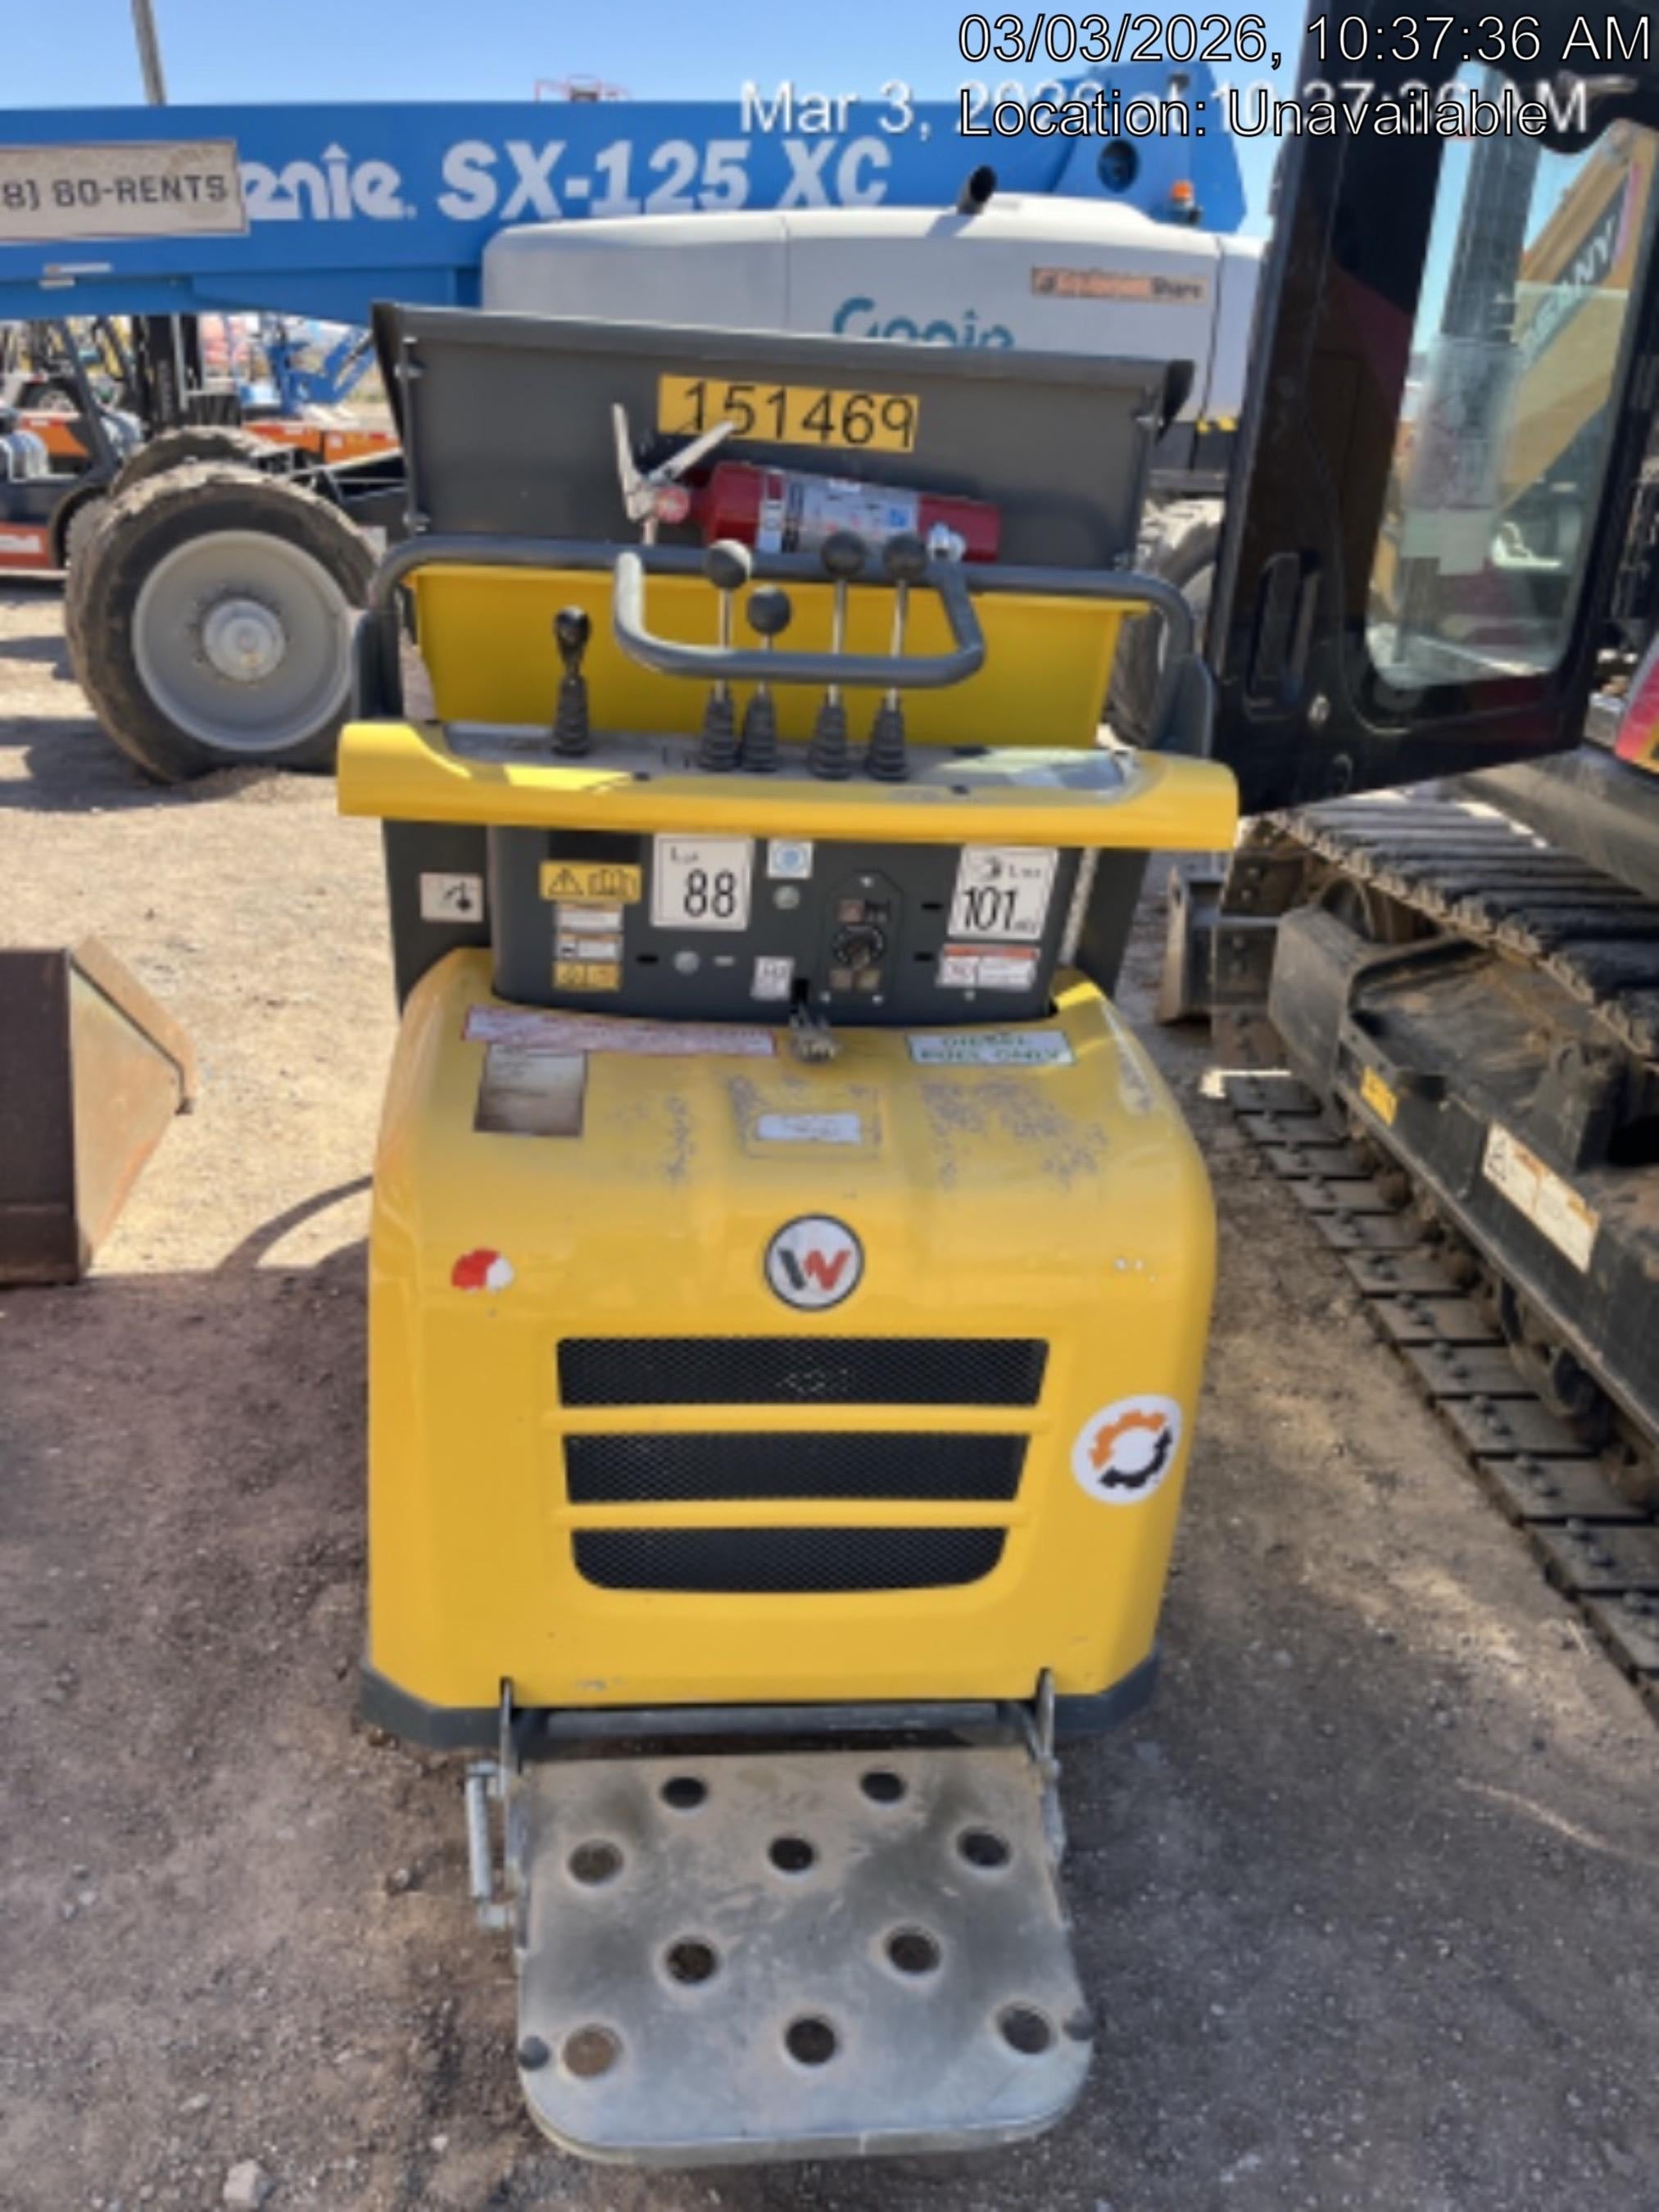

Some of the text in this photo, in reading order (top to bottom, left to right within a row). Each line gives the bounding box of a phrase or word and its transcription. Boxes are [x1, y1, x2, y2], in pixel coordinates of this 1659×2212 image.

[236, 137, 892, 221] enie SX-125 XC
[684, 380, 917, 449] 151469
[683, 868, 737, 919] 88
[963, 886, 1018, 931] 101
